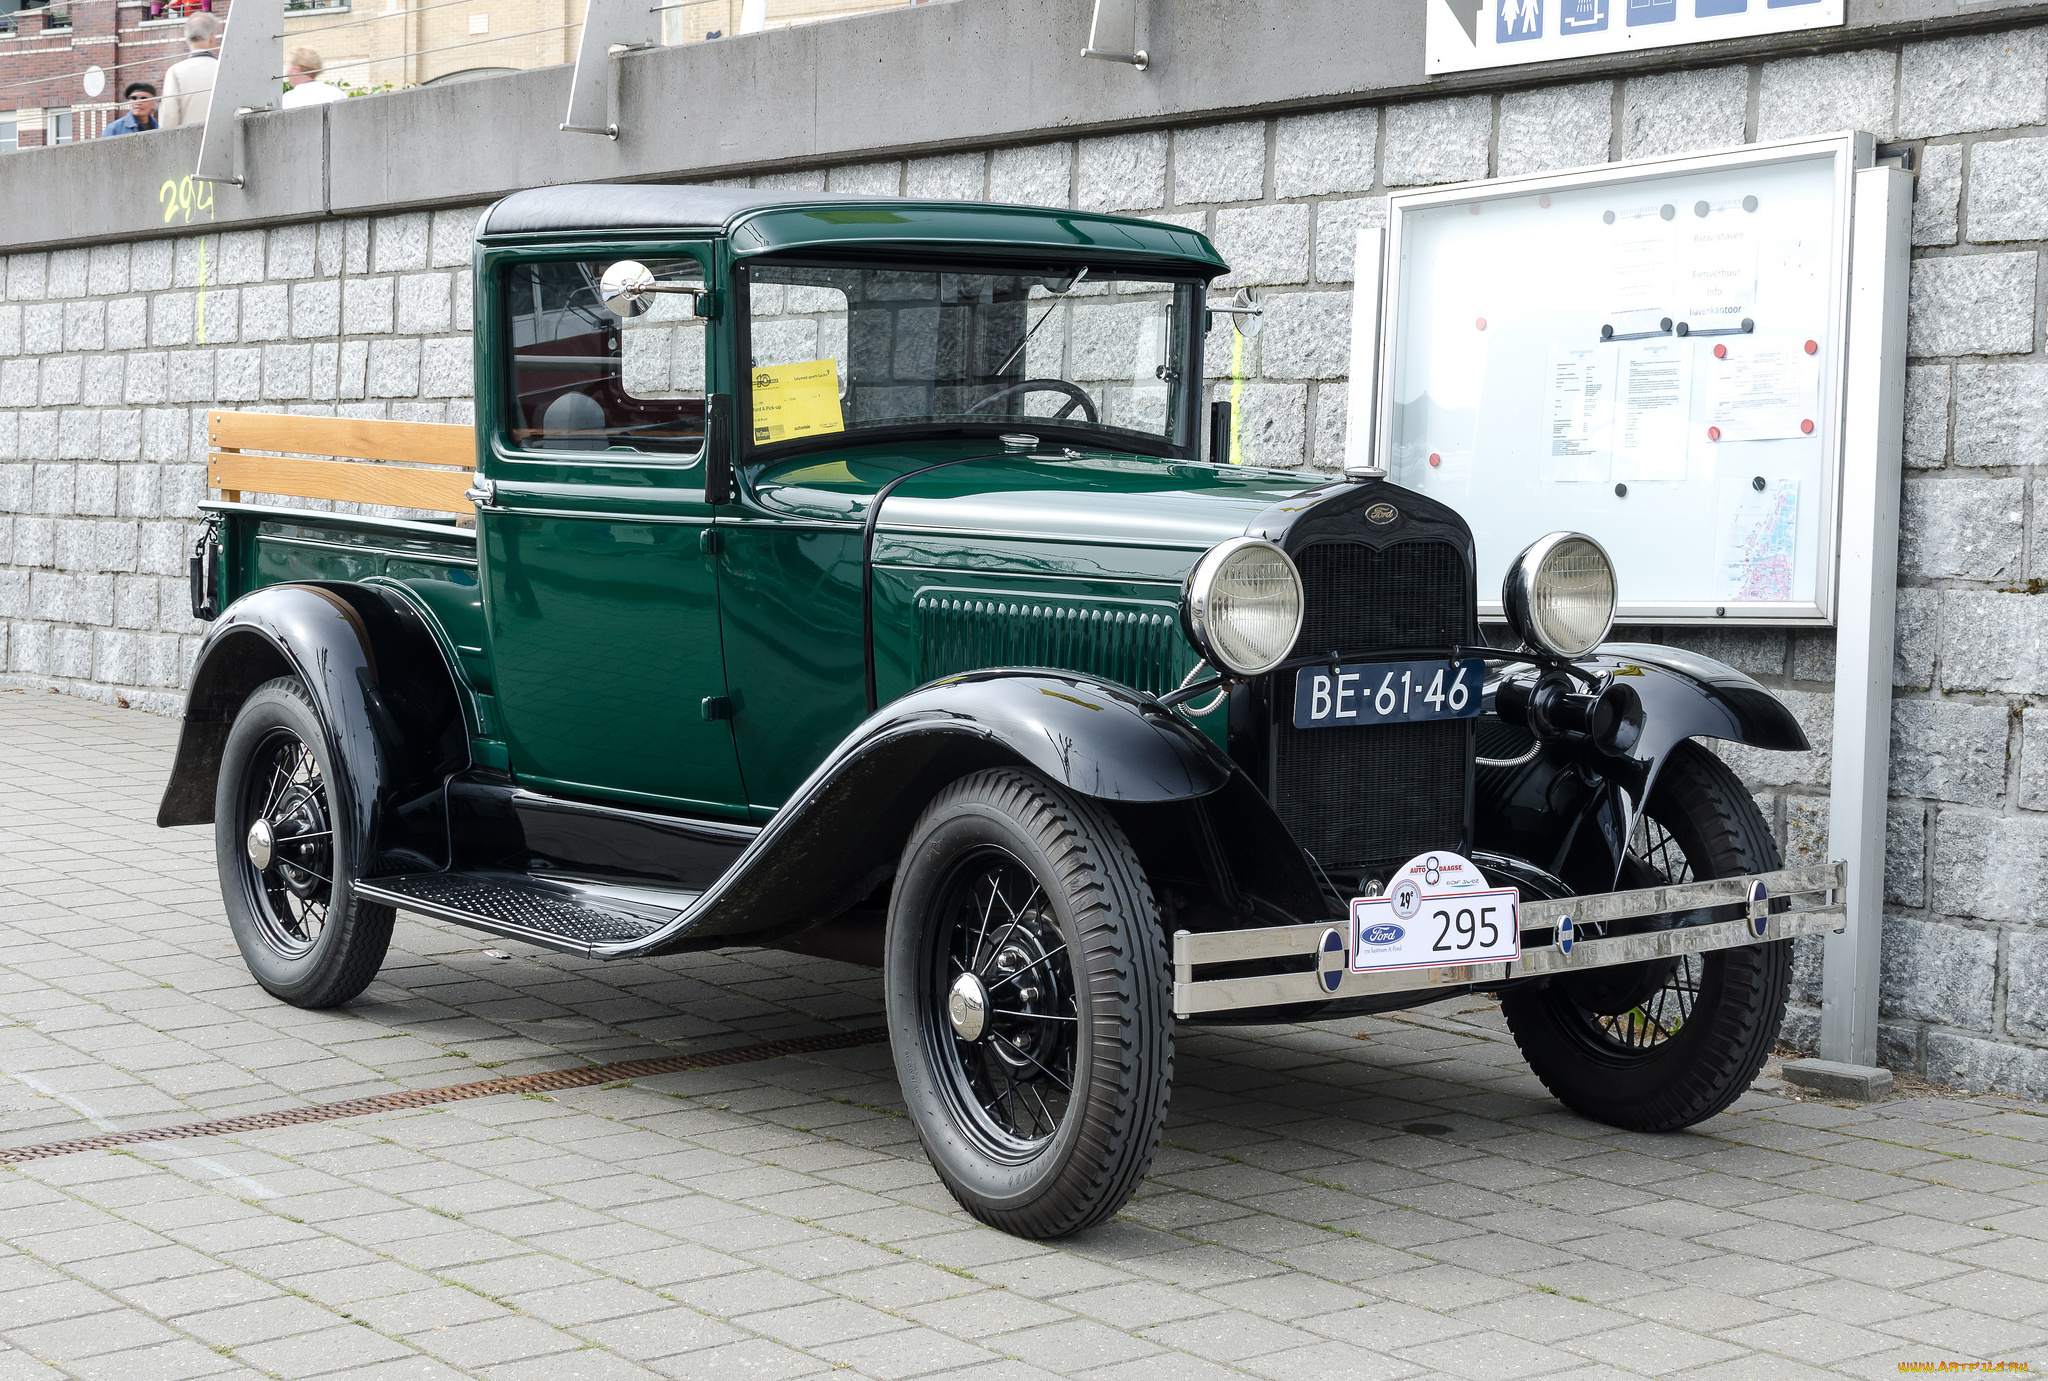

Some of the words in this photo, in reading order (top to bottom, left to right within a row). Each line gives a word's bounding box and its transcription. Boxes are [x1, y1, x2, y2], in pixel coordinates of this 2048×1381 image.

[159, 175, 215, 223] 294
[1693, 232, 1744, 243] Bataviahaven
[1692, 268, 1741, 279] Fietsverhuur
[1707, 286, 1723, 296] Info
[1689, 305, 1743, 317] havenkantoor
[1370, 506, 1394, 520] Ford
[1310, 667, 1469, 720] BE-61-46
[1439, 864, 1463, 872] DAAGSE
[1369, 926, 1396, 942] Ford
[1432, 907, 1499, 952] 295
